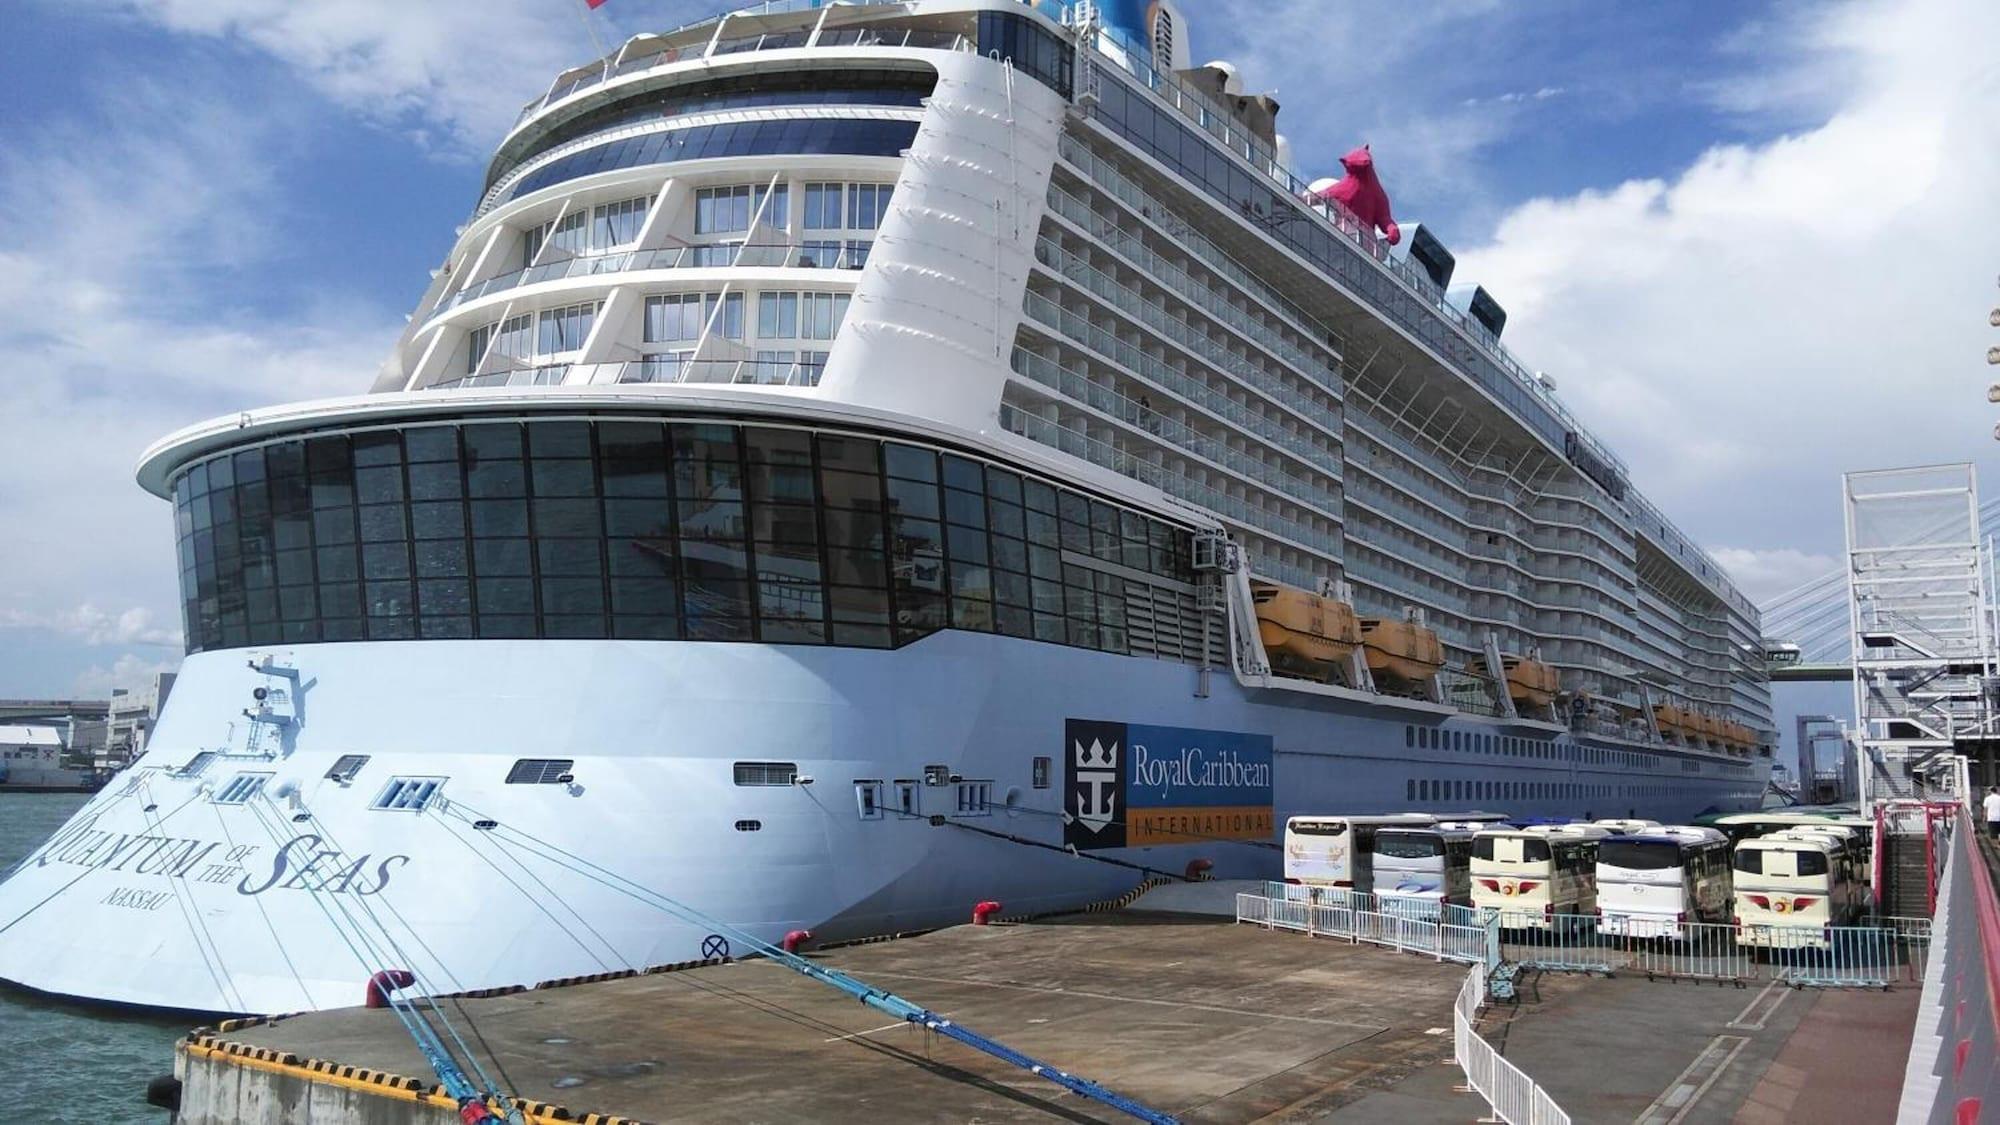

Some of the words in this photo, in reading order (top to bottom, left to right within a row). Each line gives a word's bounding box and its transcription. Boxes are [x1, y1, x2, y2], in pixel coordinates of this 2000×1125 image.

[1135, 815, 1273, 836] INTERNATIONAL
[38, 813, 222, 877] QUANTUM
[196, 864, 244, 884] THE
[100, 887, 174, 911] NASSAU
